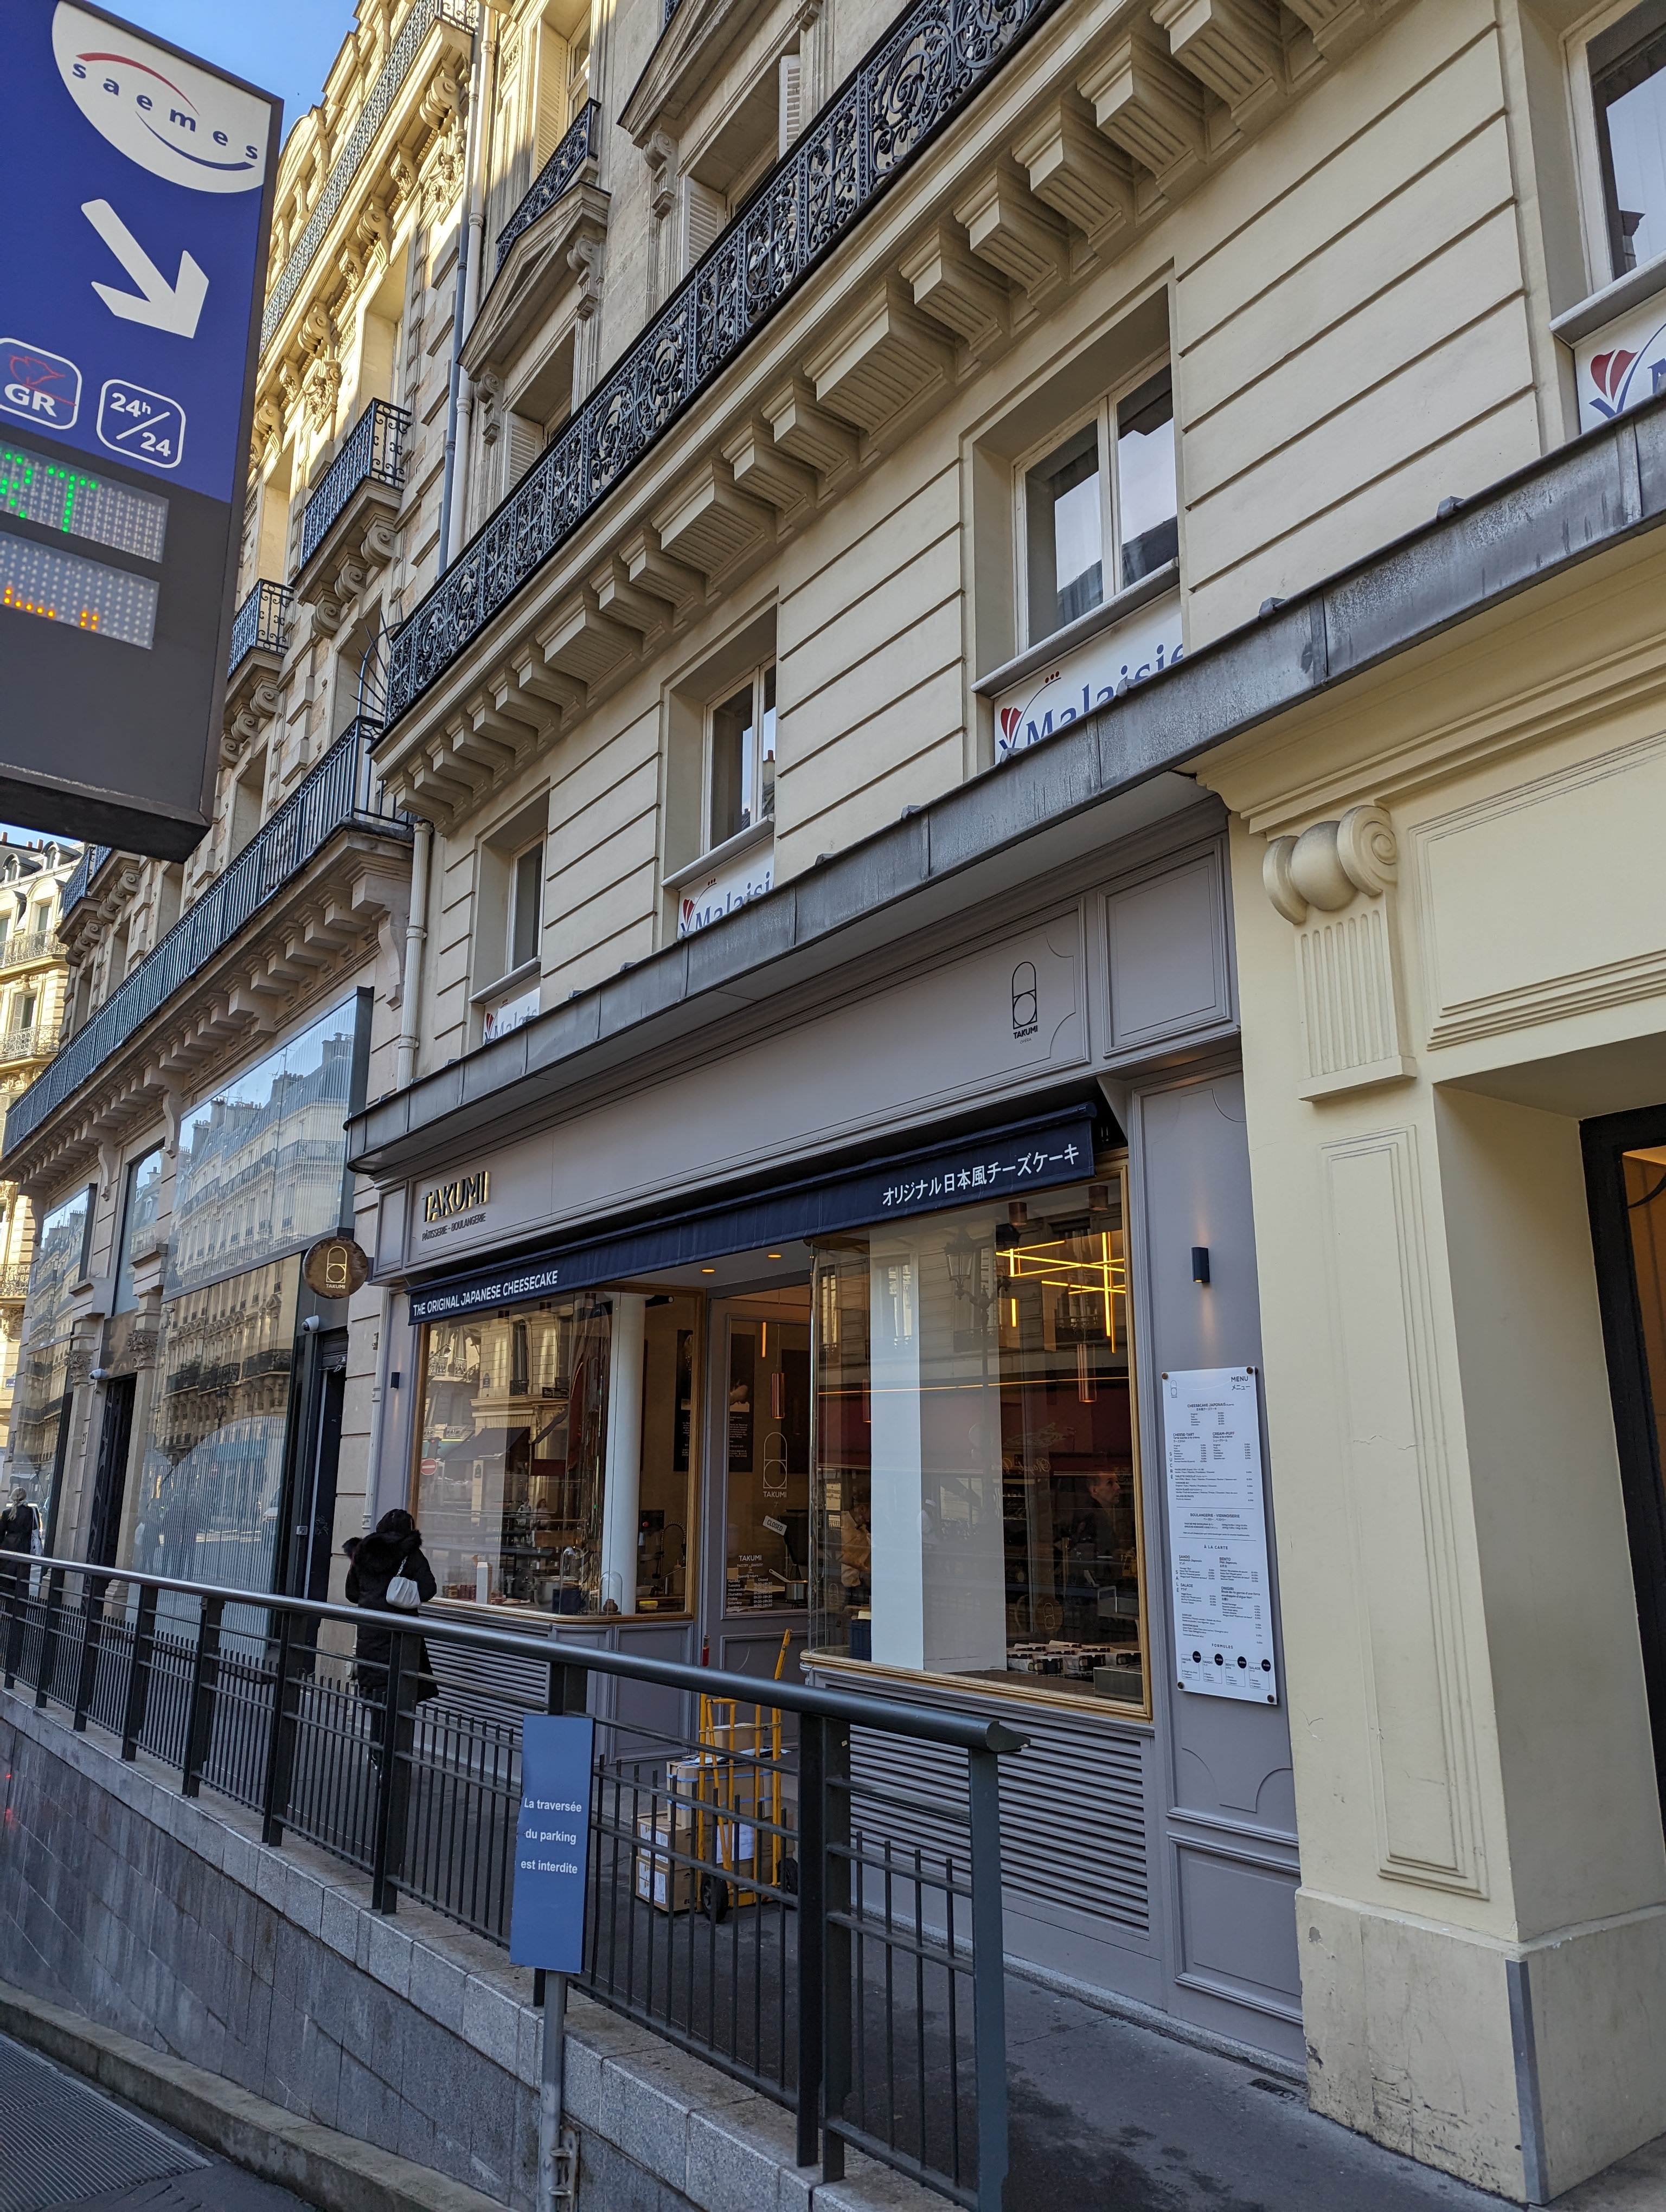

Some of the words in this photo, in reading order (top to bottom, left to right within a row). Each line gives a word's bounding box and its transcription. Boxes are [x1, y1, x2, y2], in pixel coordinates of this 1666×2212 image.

[72, 62, 258, 160] saemes
[4, 383, 56, 417] GR
[110, 392, 151, 418] 24h
[695, 871, 774, 930] Malasi
[1013, 1025, 1038, 1039] TAKUMI
[882, 1143, 1079, 1206] オリジナル日本風チーズケーキ
[421, 1171, 490, 1223] TAKUMI
[422, 1226, 447, 1242] PÂTISSERIE
[451, 1212, 486, 1231] BOULANGERIE
[413, 1303, 426, 1316] THE
[427, 1295, 460, 1312] ORIGINAL
[460, 1284, 501, 1306] JAPANESE
[503, 1270, 558, 1296] CHEESECAKE
[767, 1519, 783, 1532] CLOSED
[524, 1798, 534, 1809] La
[537, 1799, 582, 1812] traversée
[526, 1828, 537, 1839] du
[540, 1830, 576, 1846] parking
[521, 1860, 536, 1870] est
[538, 1860, 578, 1874] interdite
